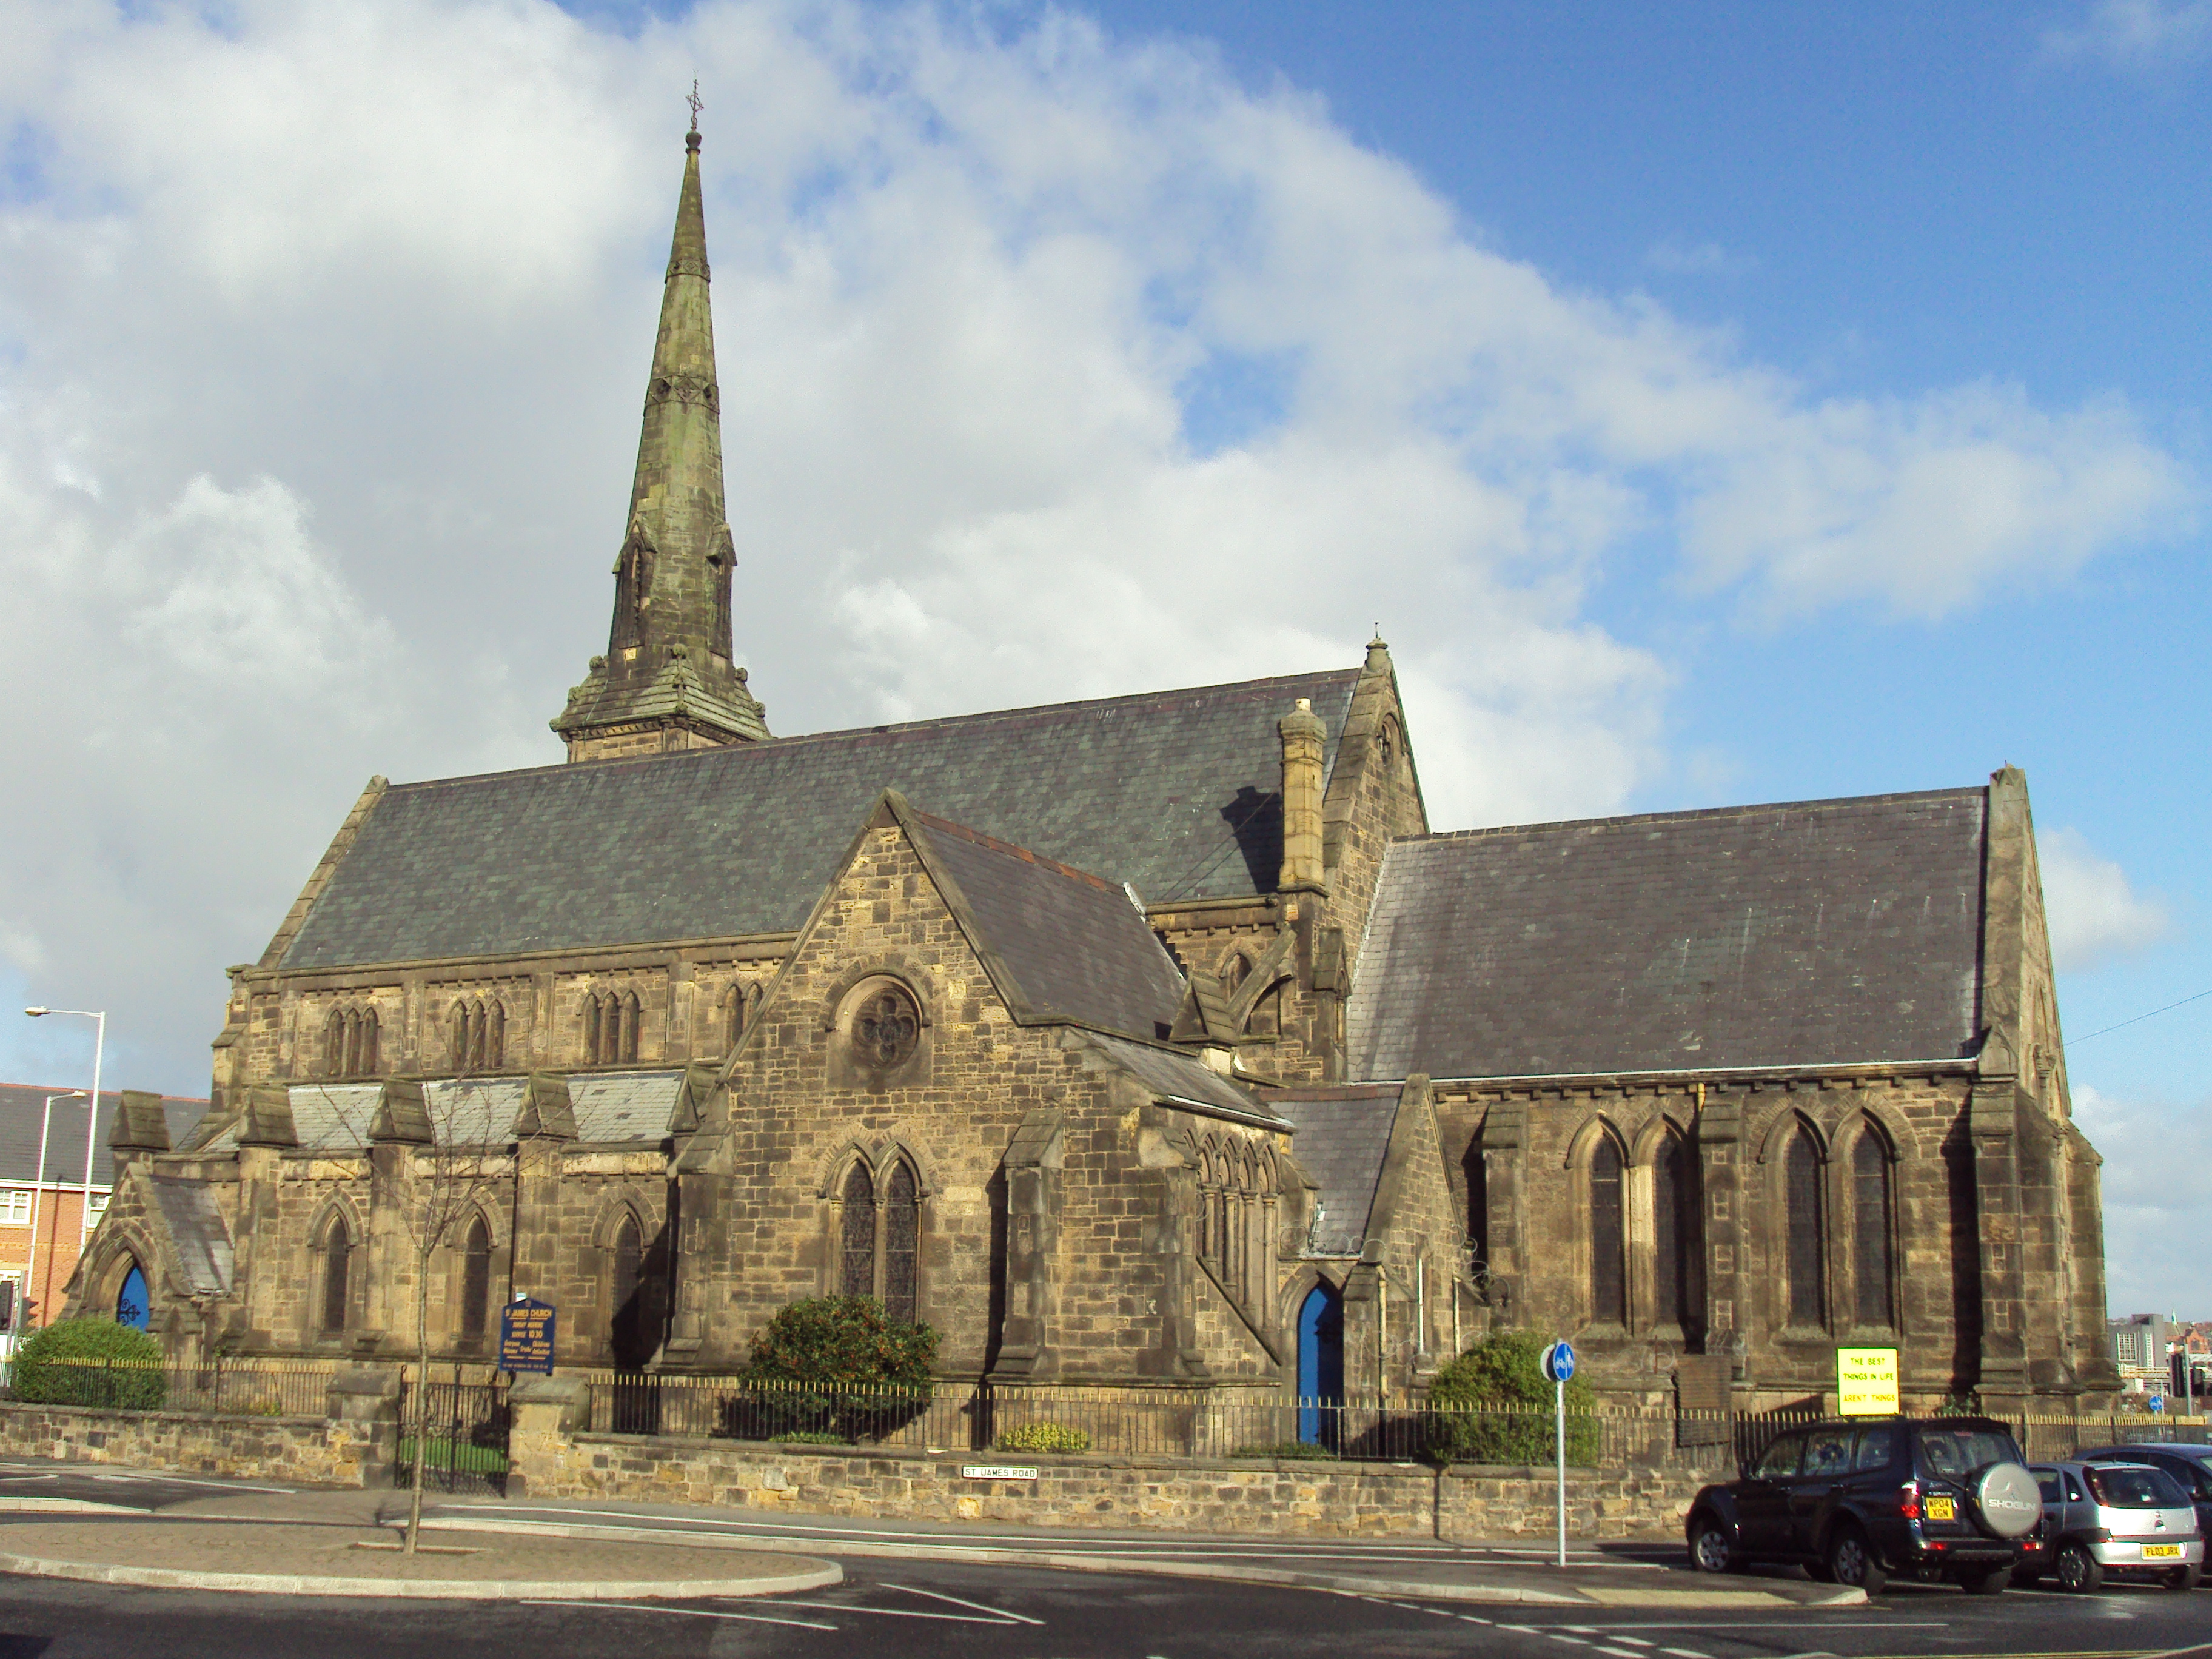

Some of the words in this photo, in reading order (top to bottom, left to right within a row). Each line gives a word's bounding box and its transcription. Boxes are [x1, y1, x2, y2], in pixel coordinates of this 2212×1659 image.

[512, 1309, 529, 1318] JAMES
[530, 1309, 552, 1318] CHURCH
[981, 1468, 1009, 1477] JAMES
[1013, 1469, 1036, 1478] ROAD
[1988, 1498, 2036, 1511] SHOGUN
